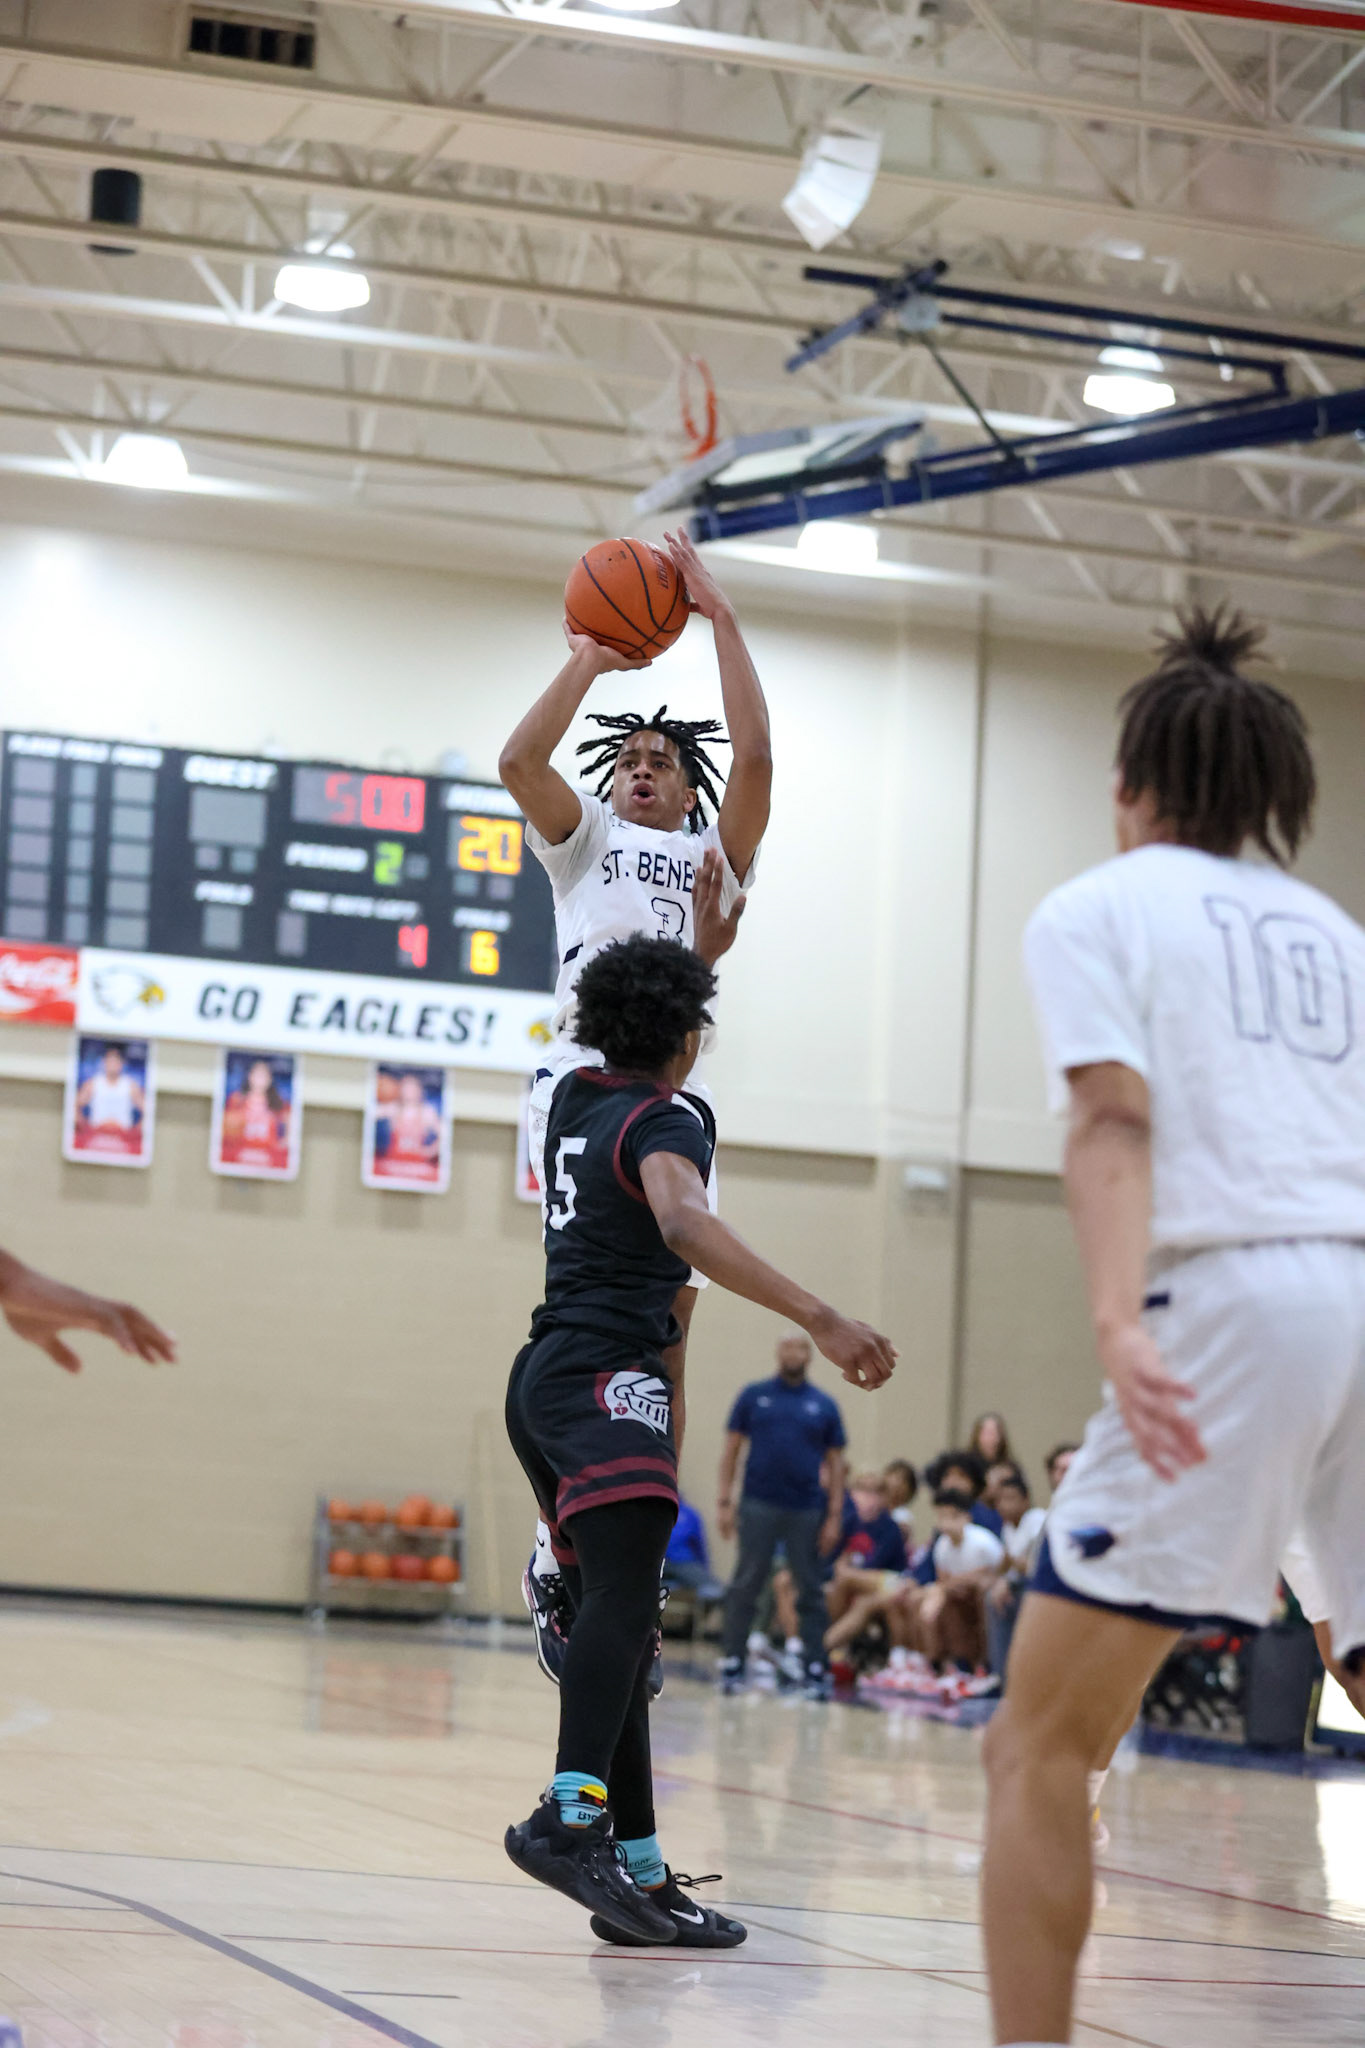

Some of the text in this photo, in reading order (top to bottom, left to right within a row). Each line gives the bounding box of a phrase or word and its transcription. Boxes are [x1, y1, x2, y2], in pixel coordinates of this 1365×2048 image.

[374, 842, 404, 885] 2
[458, 815, 523, 875] 20
[602, 849, 696, 893] ST. BENE
[398, 924, 429, 968] 4
[651, 897, 685, 946] 3
[470, 930, 500, 976] 6
[1202, 894, 1355, 1065] 10
[198, 984, 497, 1047] GO EAGLES!
[549, 1136, 588, 1231] 5
